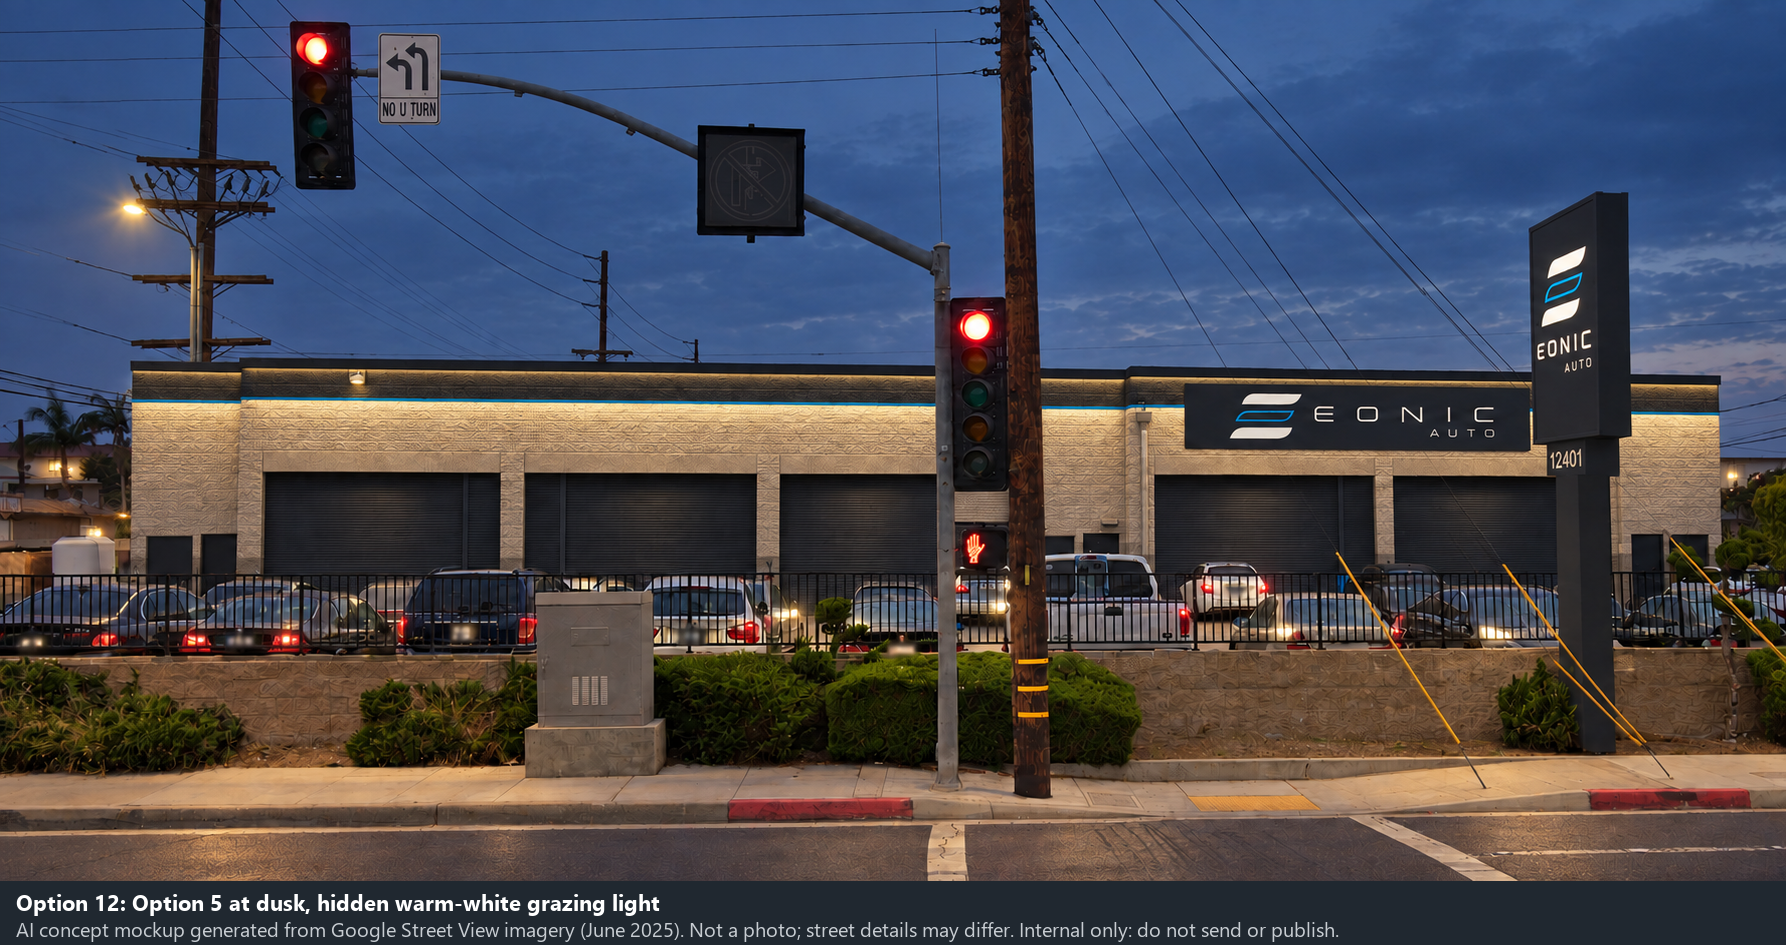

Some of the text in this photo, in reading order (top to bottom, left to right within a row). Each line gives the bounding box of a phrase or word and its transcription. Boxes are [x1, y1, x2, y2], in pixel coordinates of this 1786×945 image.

[382, 102, 436, 117] NO U TURN
[1537, 329, 1592, 361] EONIC
[1564, 357, 1592, 373] AUTO
[1314, 406, 1494, 423] EONIC
[1430, 428, 1495, 438] AUTO
[1550, 448, 1583, 470] 12401
